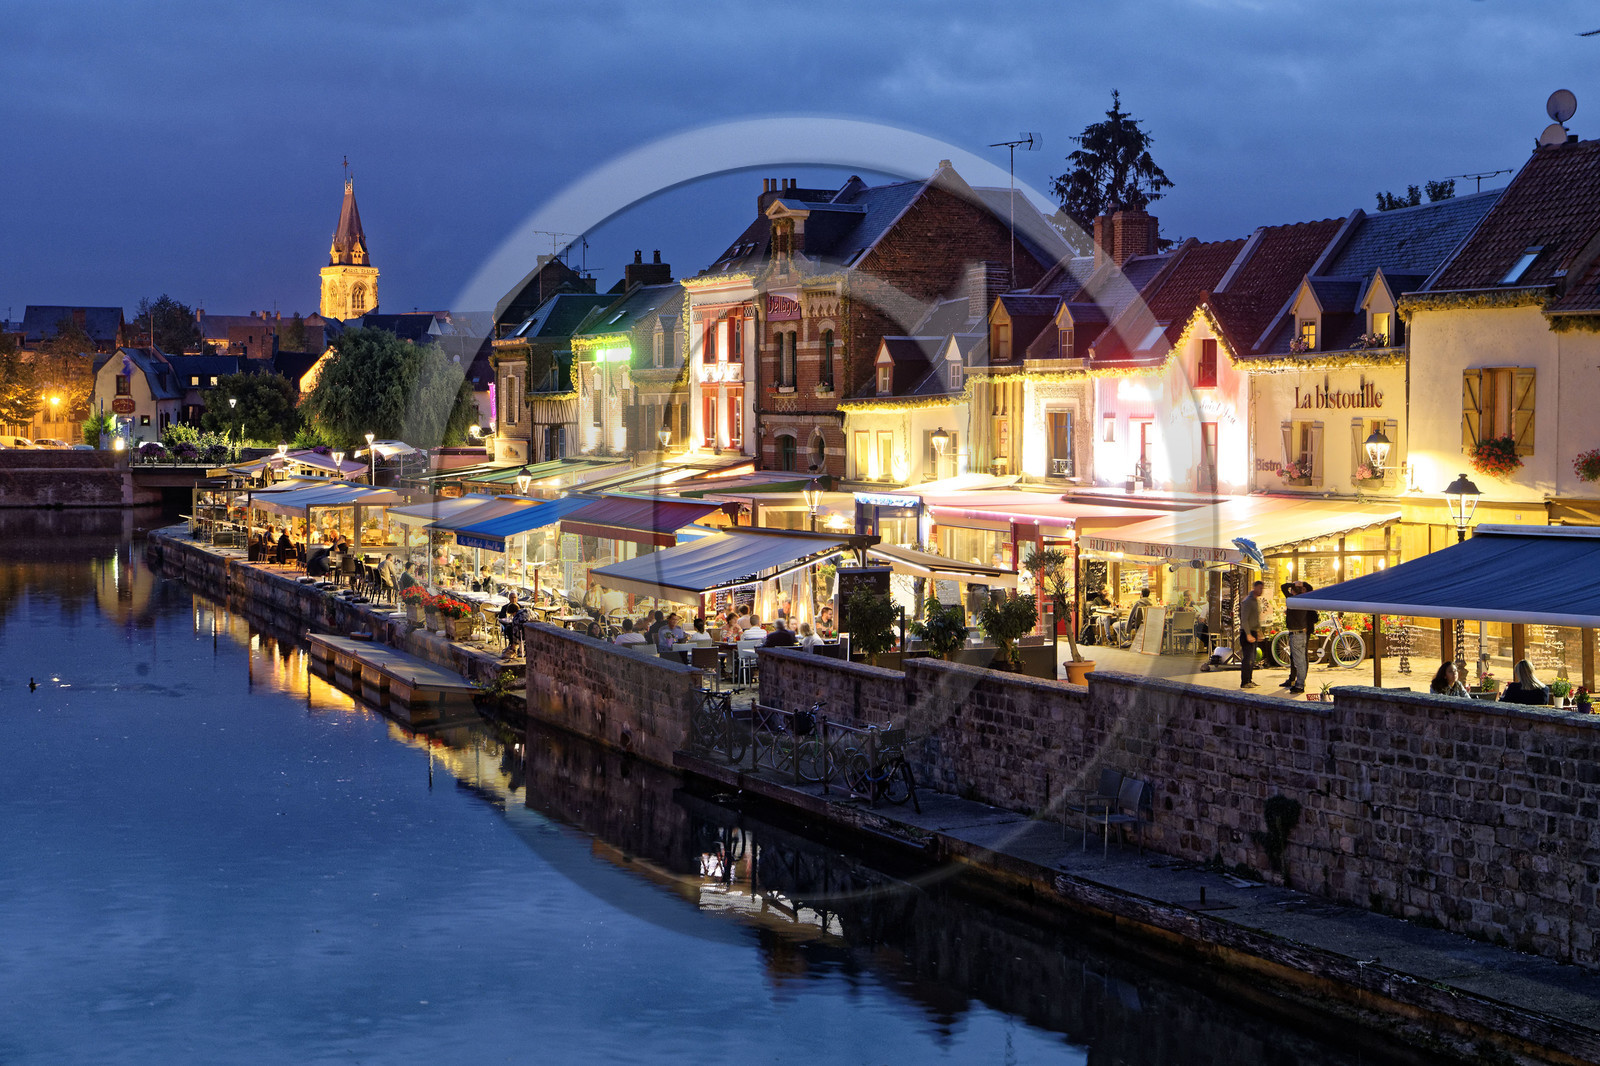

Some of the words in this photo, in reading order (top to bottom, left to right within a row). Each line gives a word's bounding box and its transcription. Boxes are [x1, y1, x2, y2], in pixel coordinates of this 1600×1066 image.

[767, 295, 799, 317] Bellagio
[1294, 386, 1311, 409] La
[1315, 379, 1383, 409] bistouille
[1255, 458, 1282, 471] Bistro
[1089, 539, 1126, 551] HUITRES
[1144, 545, 1173, 558] RESTO
[1193, 548, 1227, 561] BISTRO
